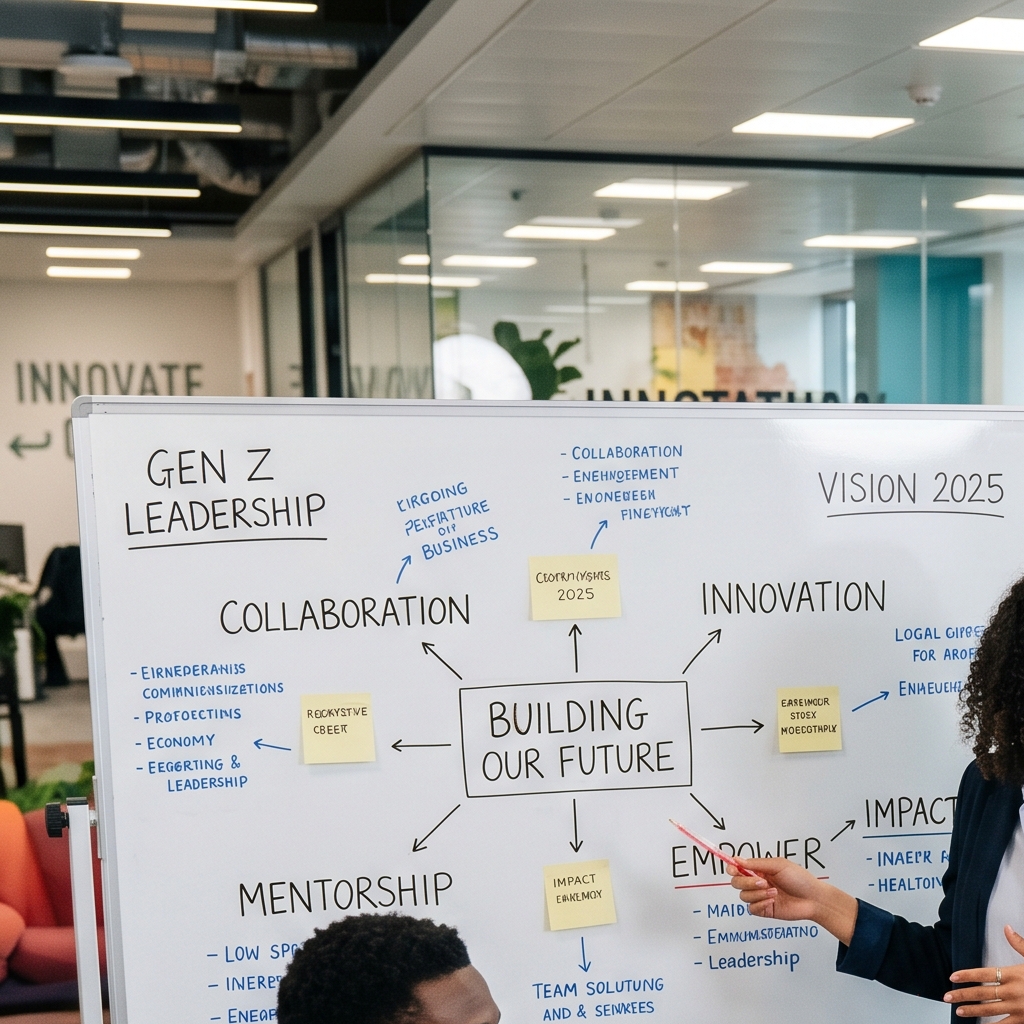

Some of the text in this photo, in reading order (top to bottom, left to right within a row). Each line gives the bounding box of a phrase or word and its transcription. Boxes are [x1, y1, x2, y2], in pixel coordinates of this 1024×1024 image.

[572, 445, 682, 460] COLLABORATION
[148, 448, 274, 488] GEN Z
[818, 472, 1003, 504] VISION 2025
[124, 492, 327, 536] LEADERSHIP
[421, 526, 499, 561] BUSINESS
[558, 588, 594, 600] 2025
[703, 580, 885, 615] INNOVATION
[220, 594, 469, 634] COLLABORATION
[913, 649, 936, 662] FOR
[490, 698, 648, 738] BUILDING
[147, 734, 215, 750] ECONOMY
[231, 755, 240, 769] &
[483, 741, 674, 781] OUR FUTURE
[168, 776, 247, 792] LEADERSHIP
[554, 874, 595, 887] IMPACT
[239, 871, 453, 917] MENTORSHIP
[226, 946, 259, 962] LOW
[709, 950, 799, 972] Leadership
[532, 983, 577, 999] TEAM
[543, 1008, 571, 1021] AND
[577, 1004, 586, 1018] &
